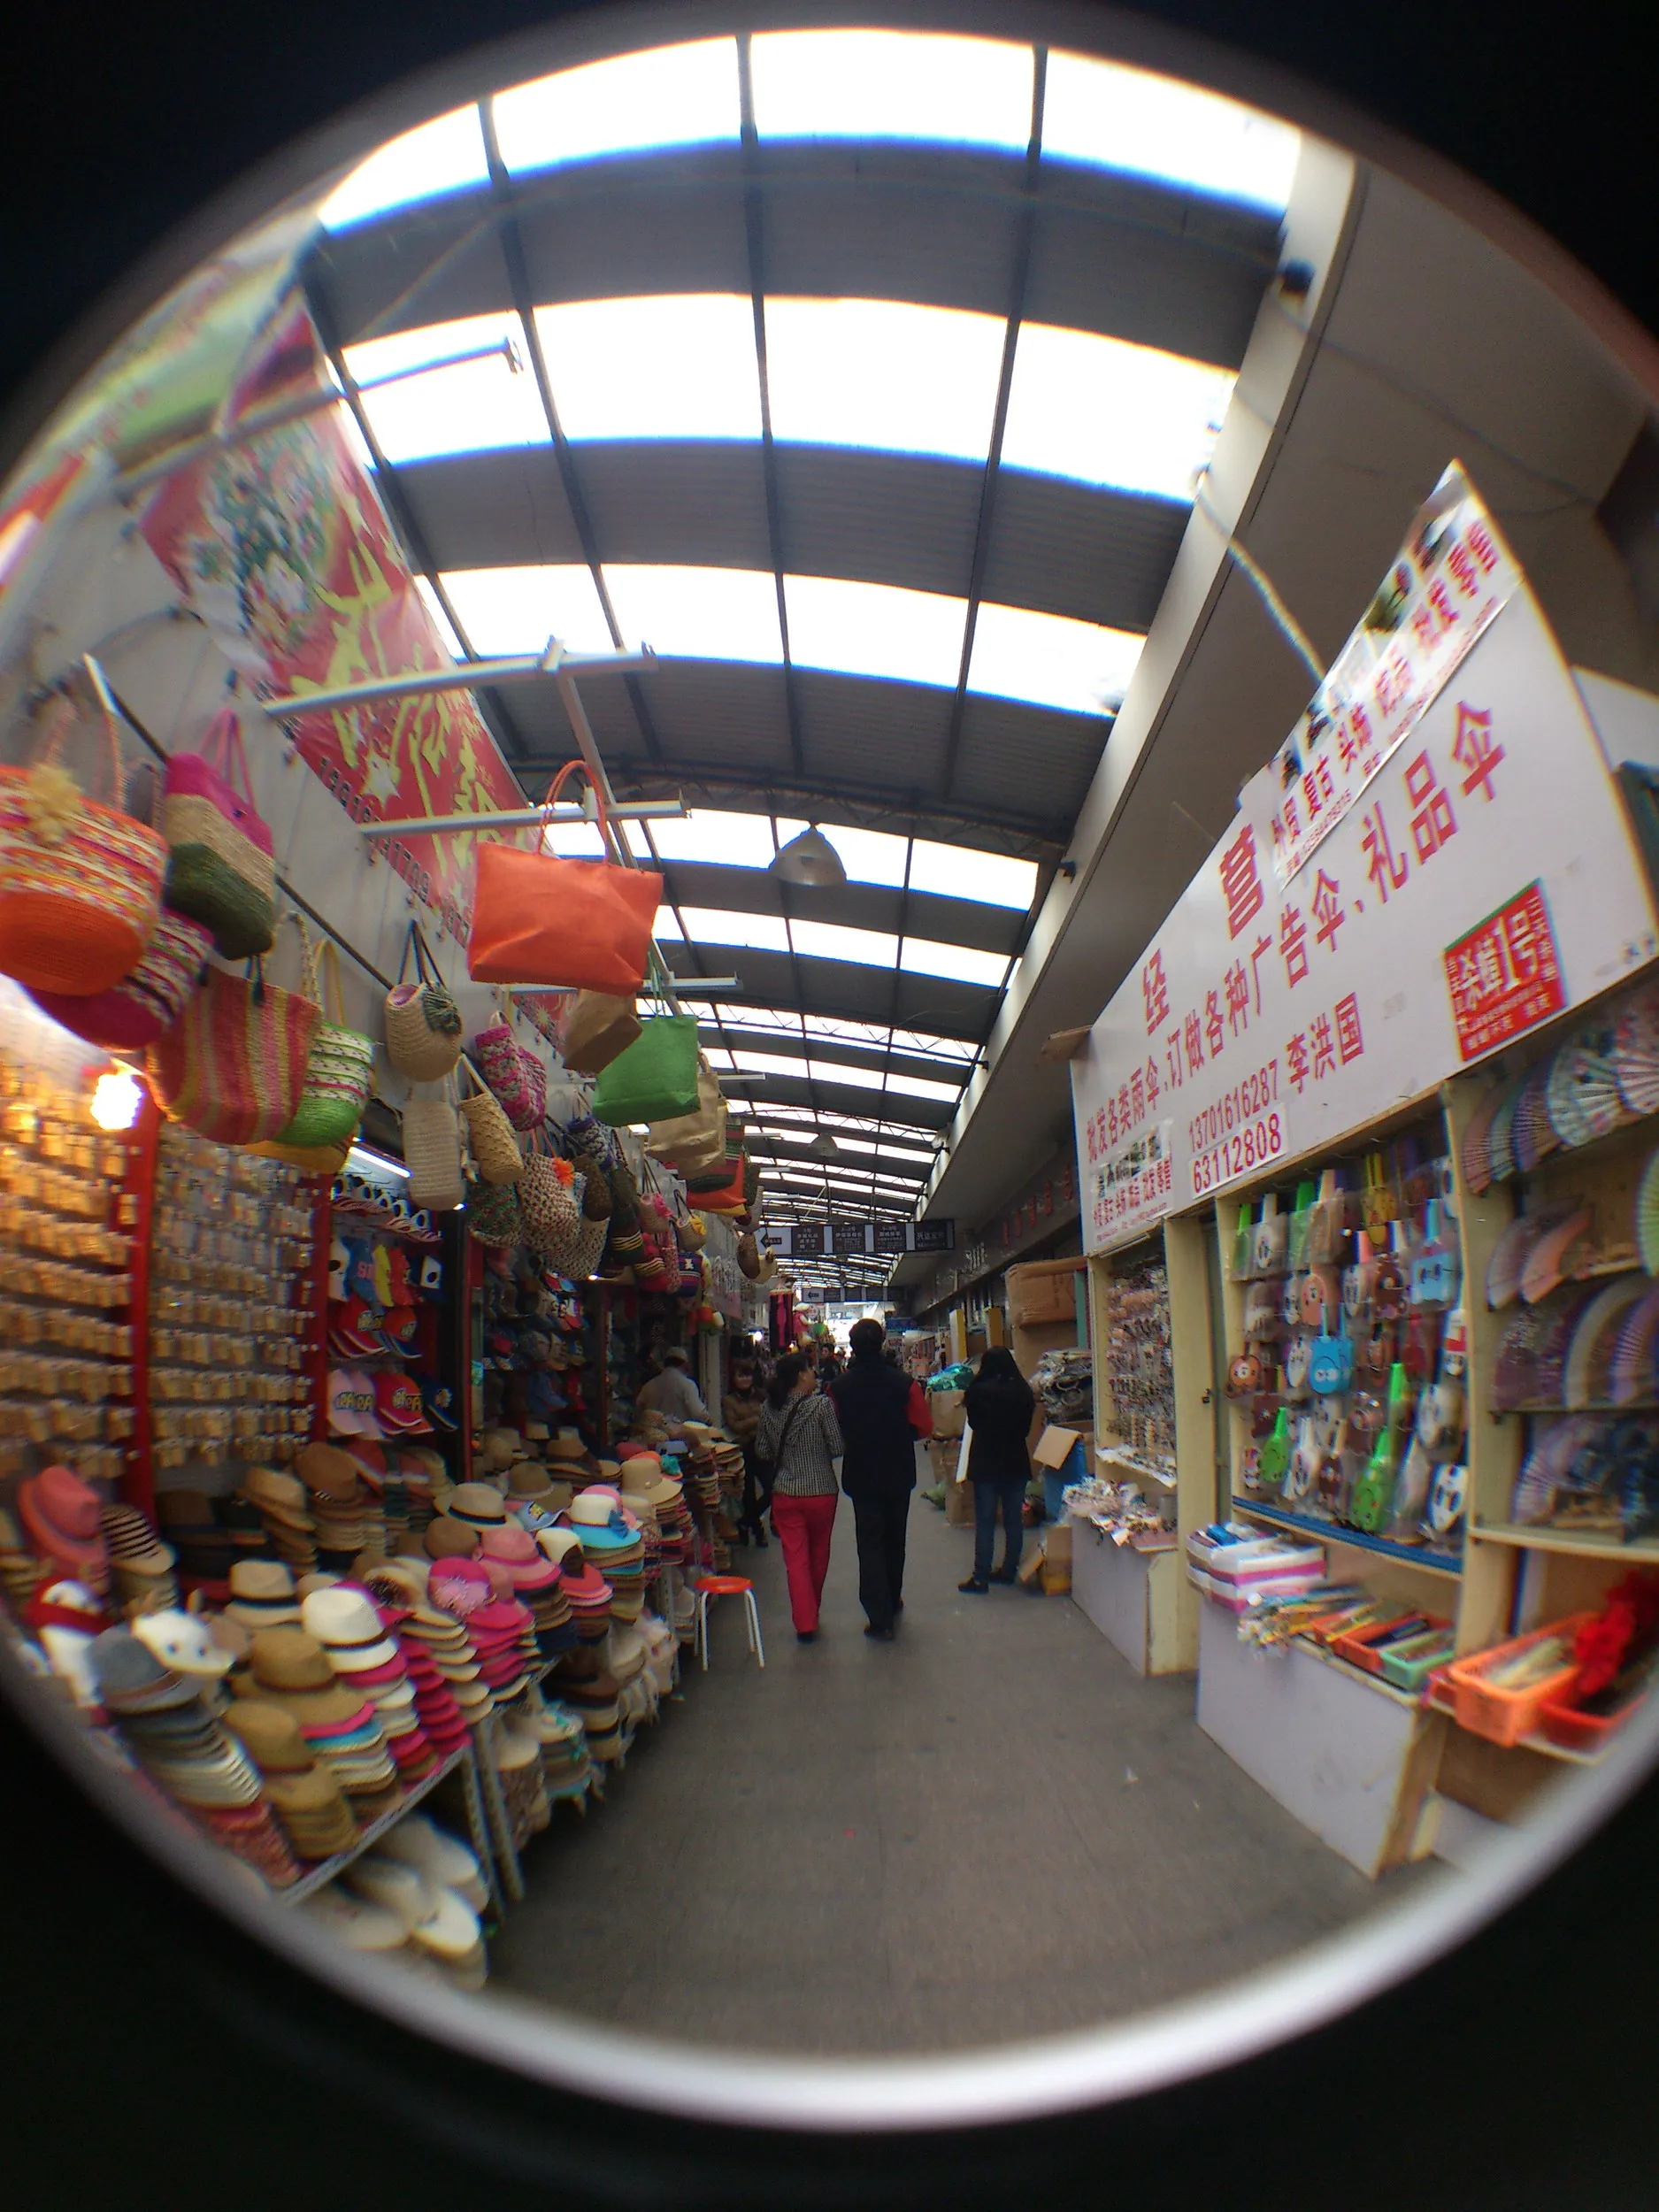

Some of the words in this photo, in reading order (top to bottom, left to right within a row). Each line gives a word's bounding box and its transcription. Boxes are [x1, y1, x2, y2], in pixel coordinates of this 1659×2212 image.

[1188, 1058, 1278, 1153] 13701616287
[1286, 990, 1364, 1094] 李洪国
[1192, 1111, 1282, 1194] 63112808
